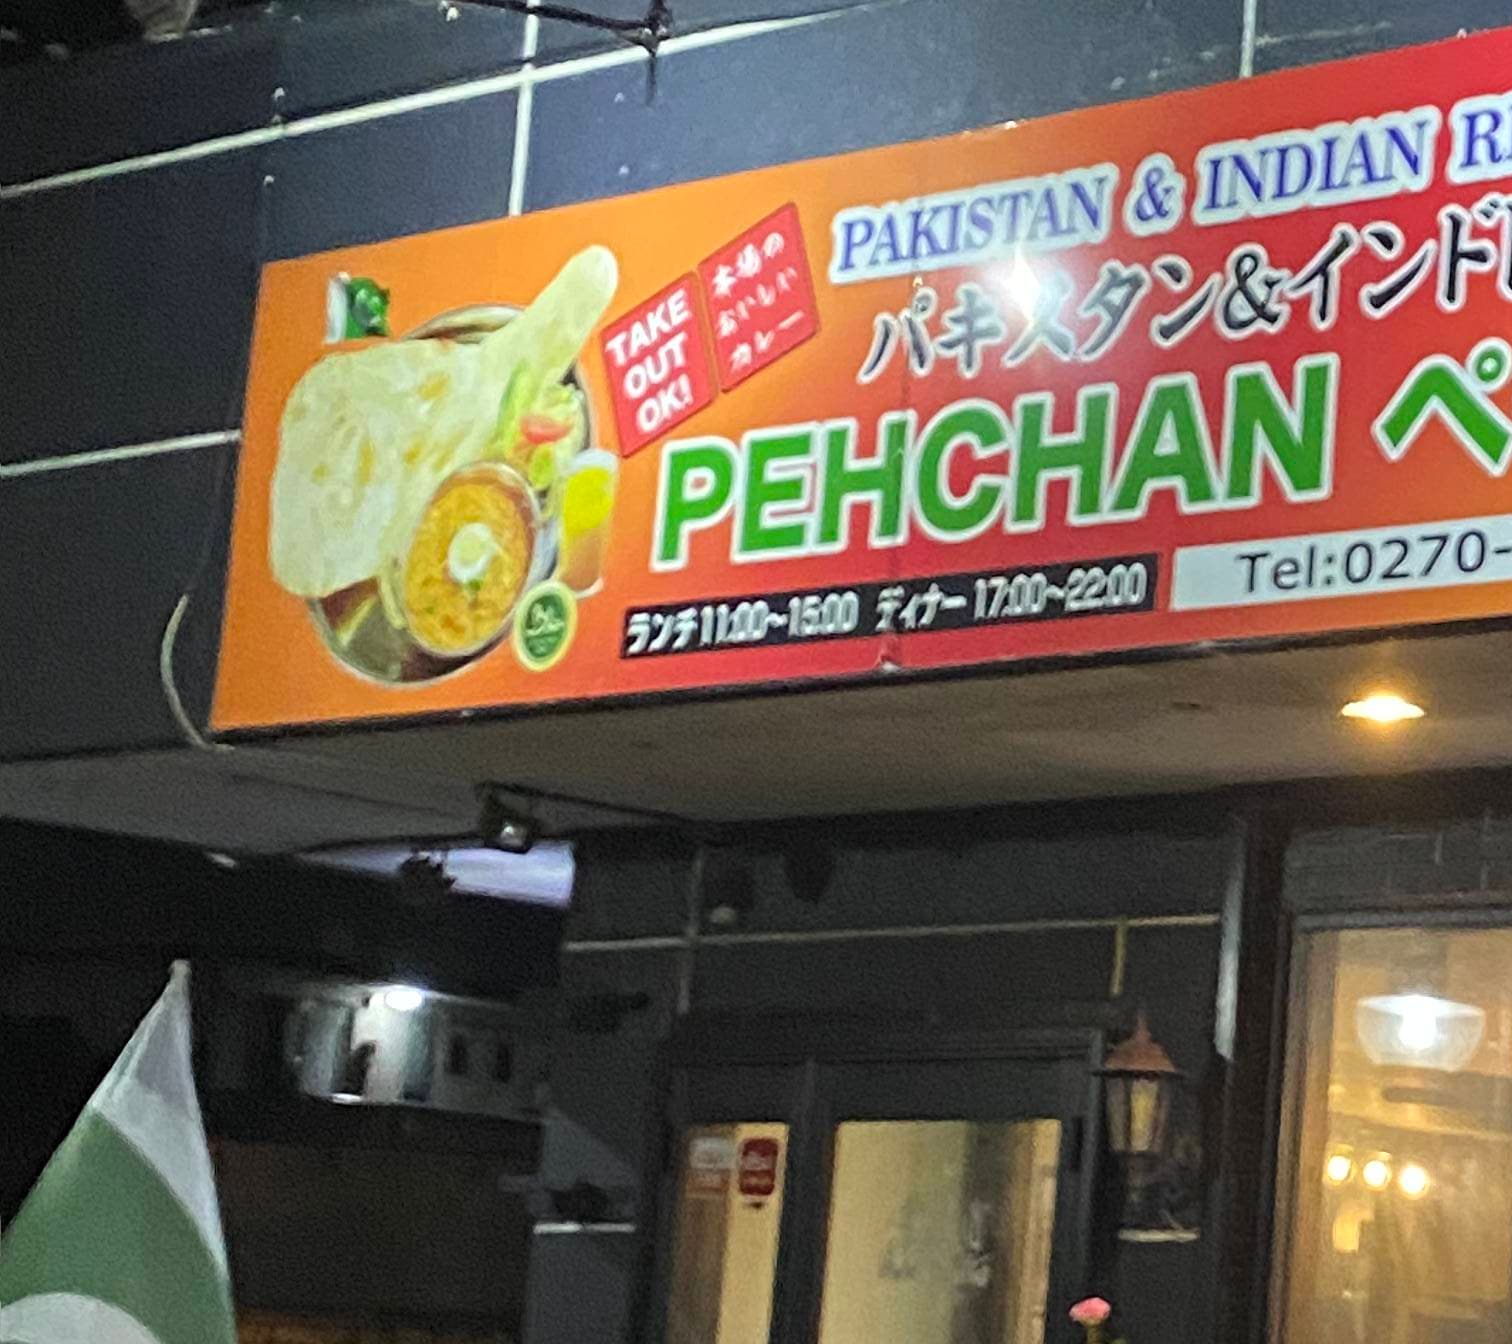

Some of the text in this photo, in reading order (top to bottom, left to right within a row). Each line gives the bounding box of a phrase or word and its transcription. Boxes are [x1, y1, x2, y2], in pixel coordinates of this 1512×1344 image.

[837, 176, 1109, 273] PAKISTAN
[1135, 166, 1173, 224] &
[1202, 120, 1431, 211] INDIAN
[605, 288, 692, 367] TAKE
[730, 311, 804, 373] カレー
[624, 332, 688, 399] OUT
[636, 373, 693, 433] OK!
[655, 356, 1337, 566] PEHCHAN
